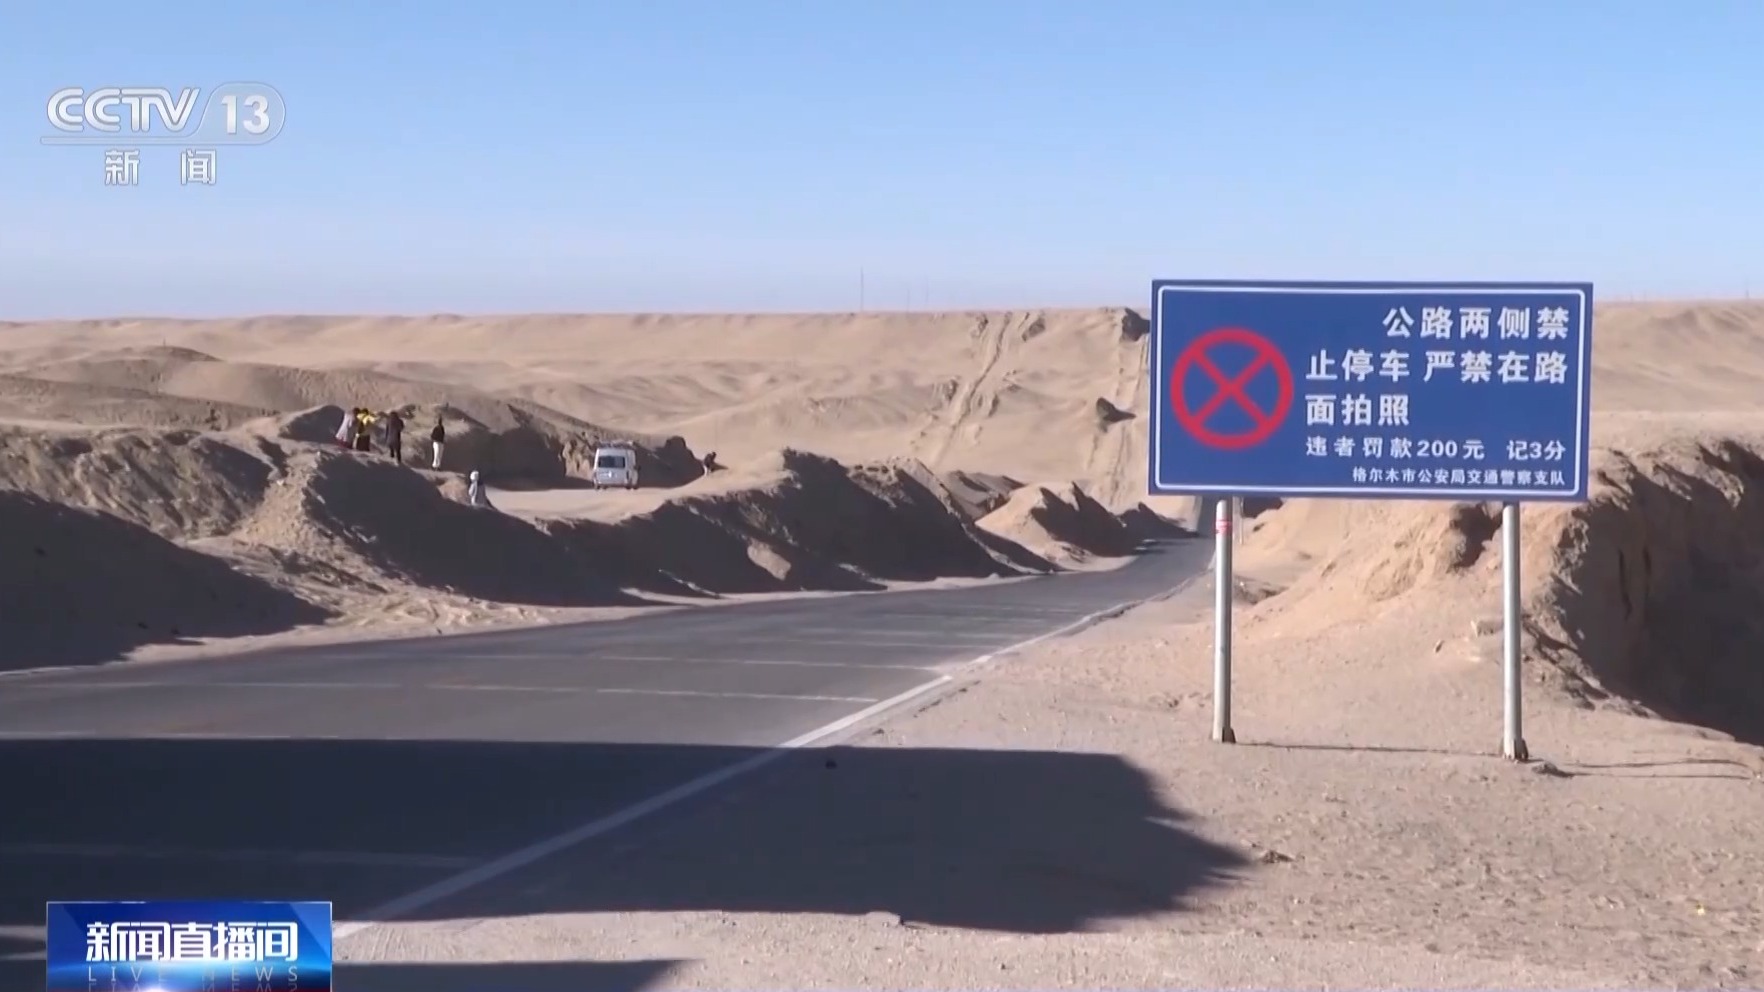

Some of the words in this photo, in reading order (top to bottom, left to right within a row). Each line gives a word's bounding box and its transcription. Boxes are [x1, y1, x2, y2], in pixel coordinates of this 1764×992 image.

[1383, 306, 1570, 339] 公路两侧禁
[1306, 349, 1410, 382] 止停车
[1424, 350, 1568, 384] 严禁在路
[1305, 393, 1409, 426] 面拍照
[1306, 436, 1485, 460] 违者罚款200元
[1507, 440, 1566, 461] 记3分
[1353, 466, 1565, 486] 格尔木市公安局交通警察支队
